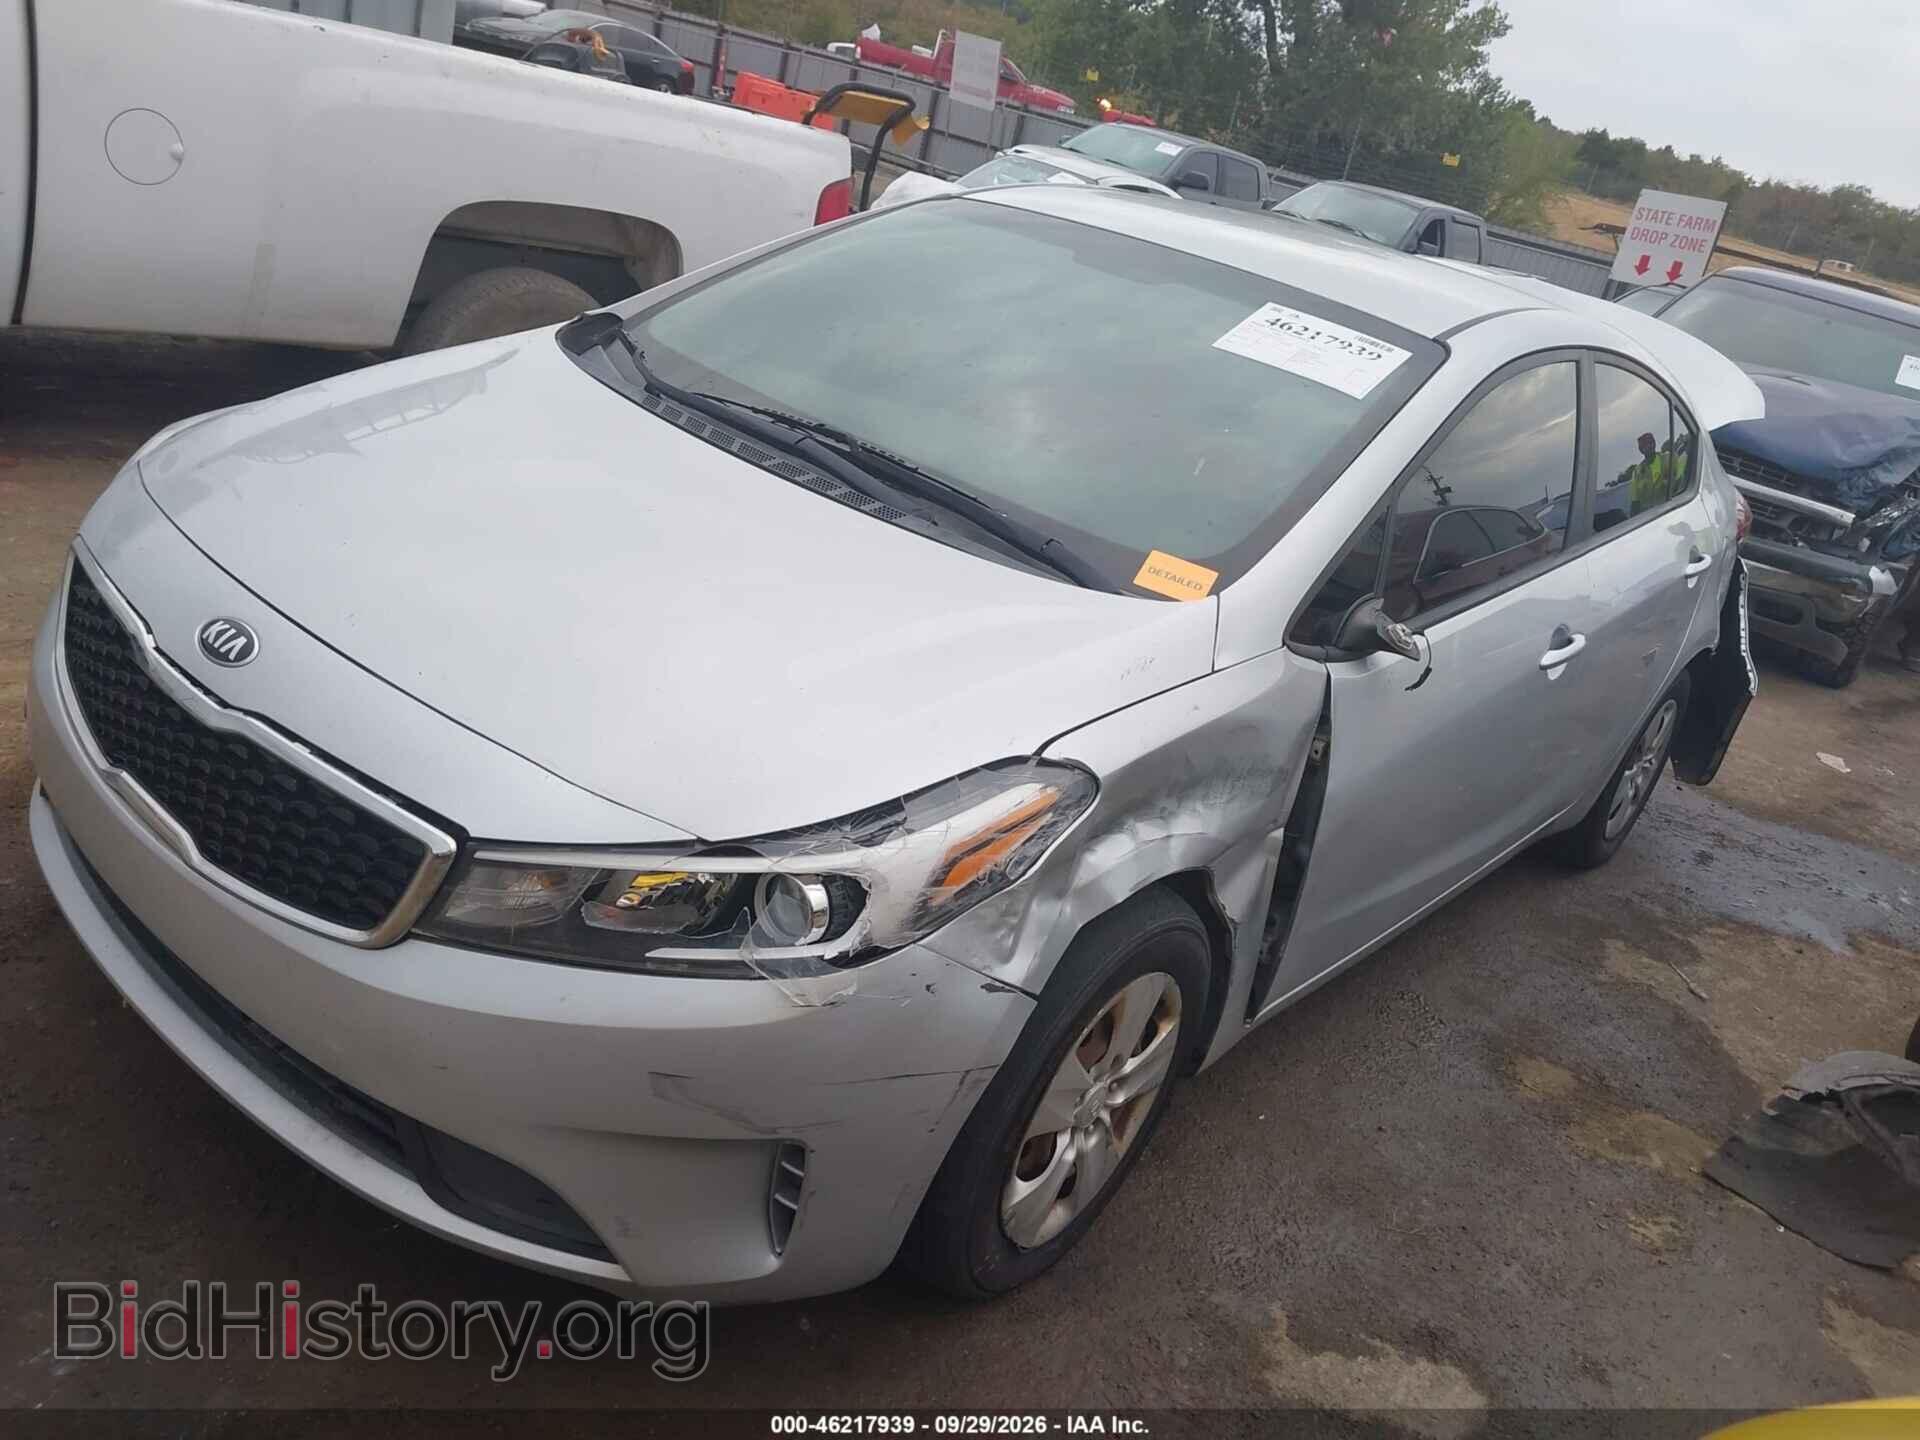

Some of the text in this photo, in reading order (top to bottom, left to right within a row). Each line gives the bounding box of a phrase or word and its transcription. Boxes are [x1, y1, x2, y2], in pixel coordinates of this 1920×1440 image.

[1635, 207, 1718, 234] STATE FARM
[1631, 226, 1708, 254] DROP ZONE
[1147, 566, 1203, 591] DETAILED
[202, 620, 247, 661] KIA
